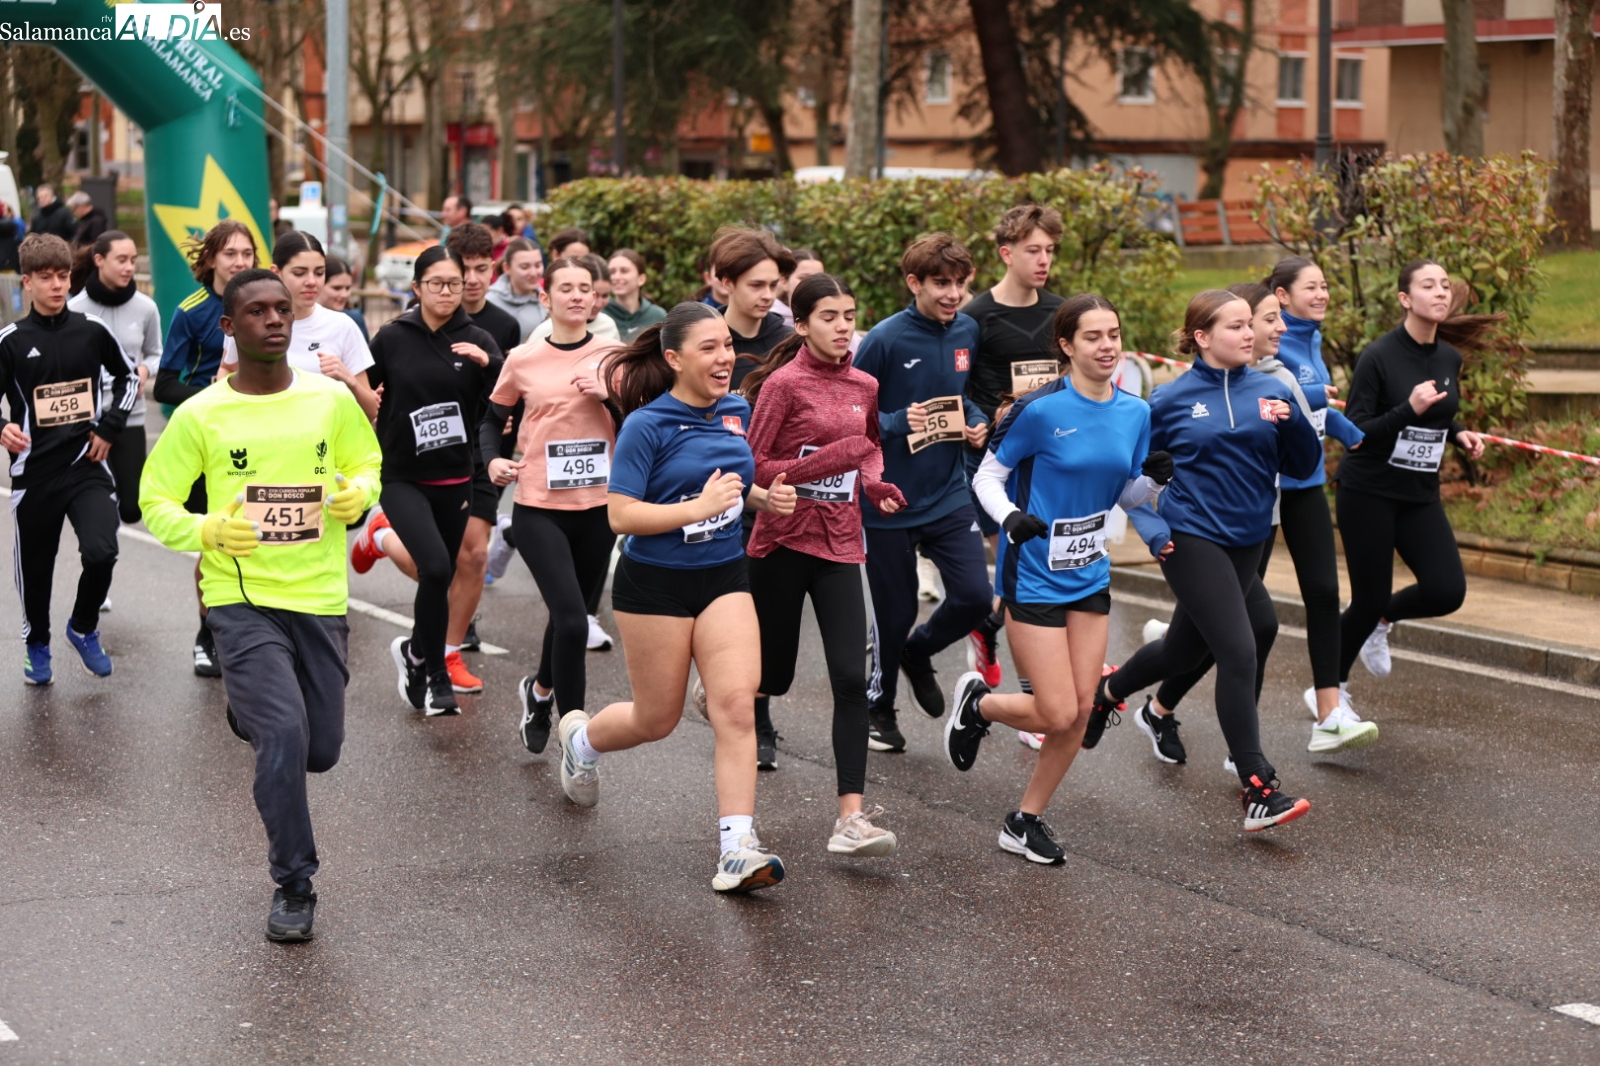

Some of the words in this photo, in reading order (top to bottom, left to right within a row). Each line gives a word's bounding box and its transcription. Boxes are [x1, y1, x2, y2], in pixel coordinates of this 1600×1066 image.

[174, 38, 225, 91] RURAL
[50, 397, 79, 413] 458
[420, 420, 449, 438] 488
[1407, 444, 1433, 459] 493
[562, 458, 595, 475] 496
[263, 507, 306, 527] 451
[1066, 535, 1096, 555] 494
